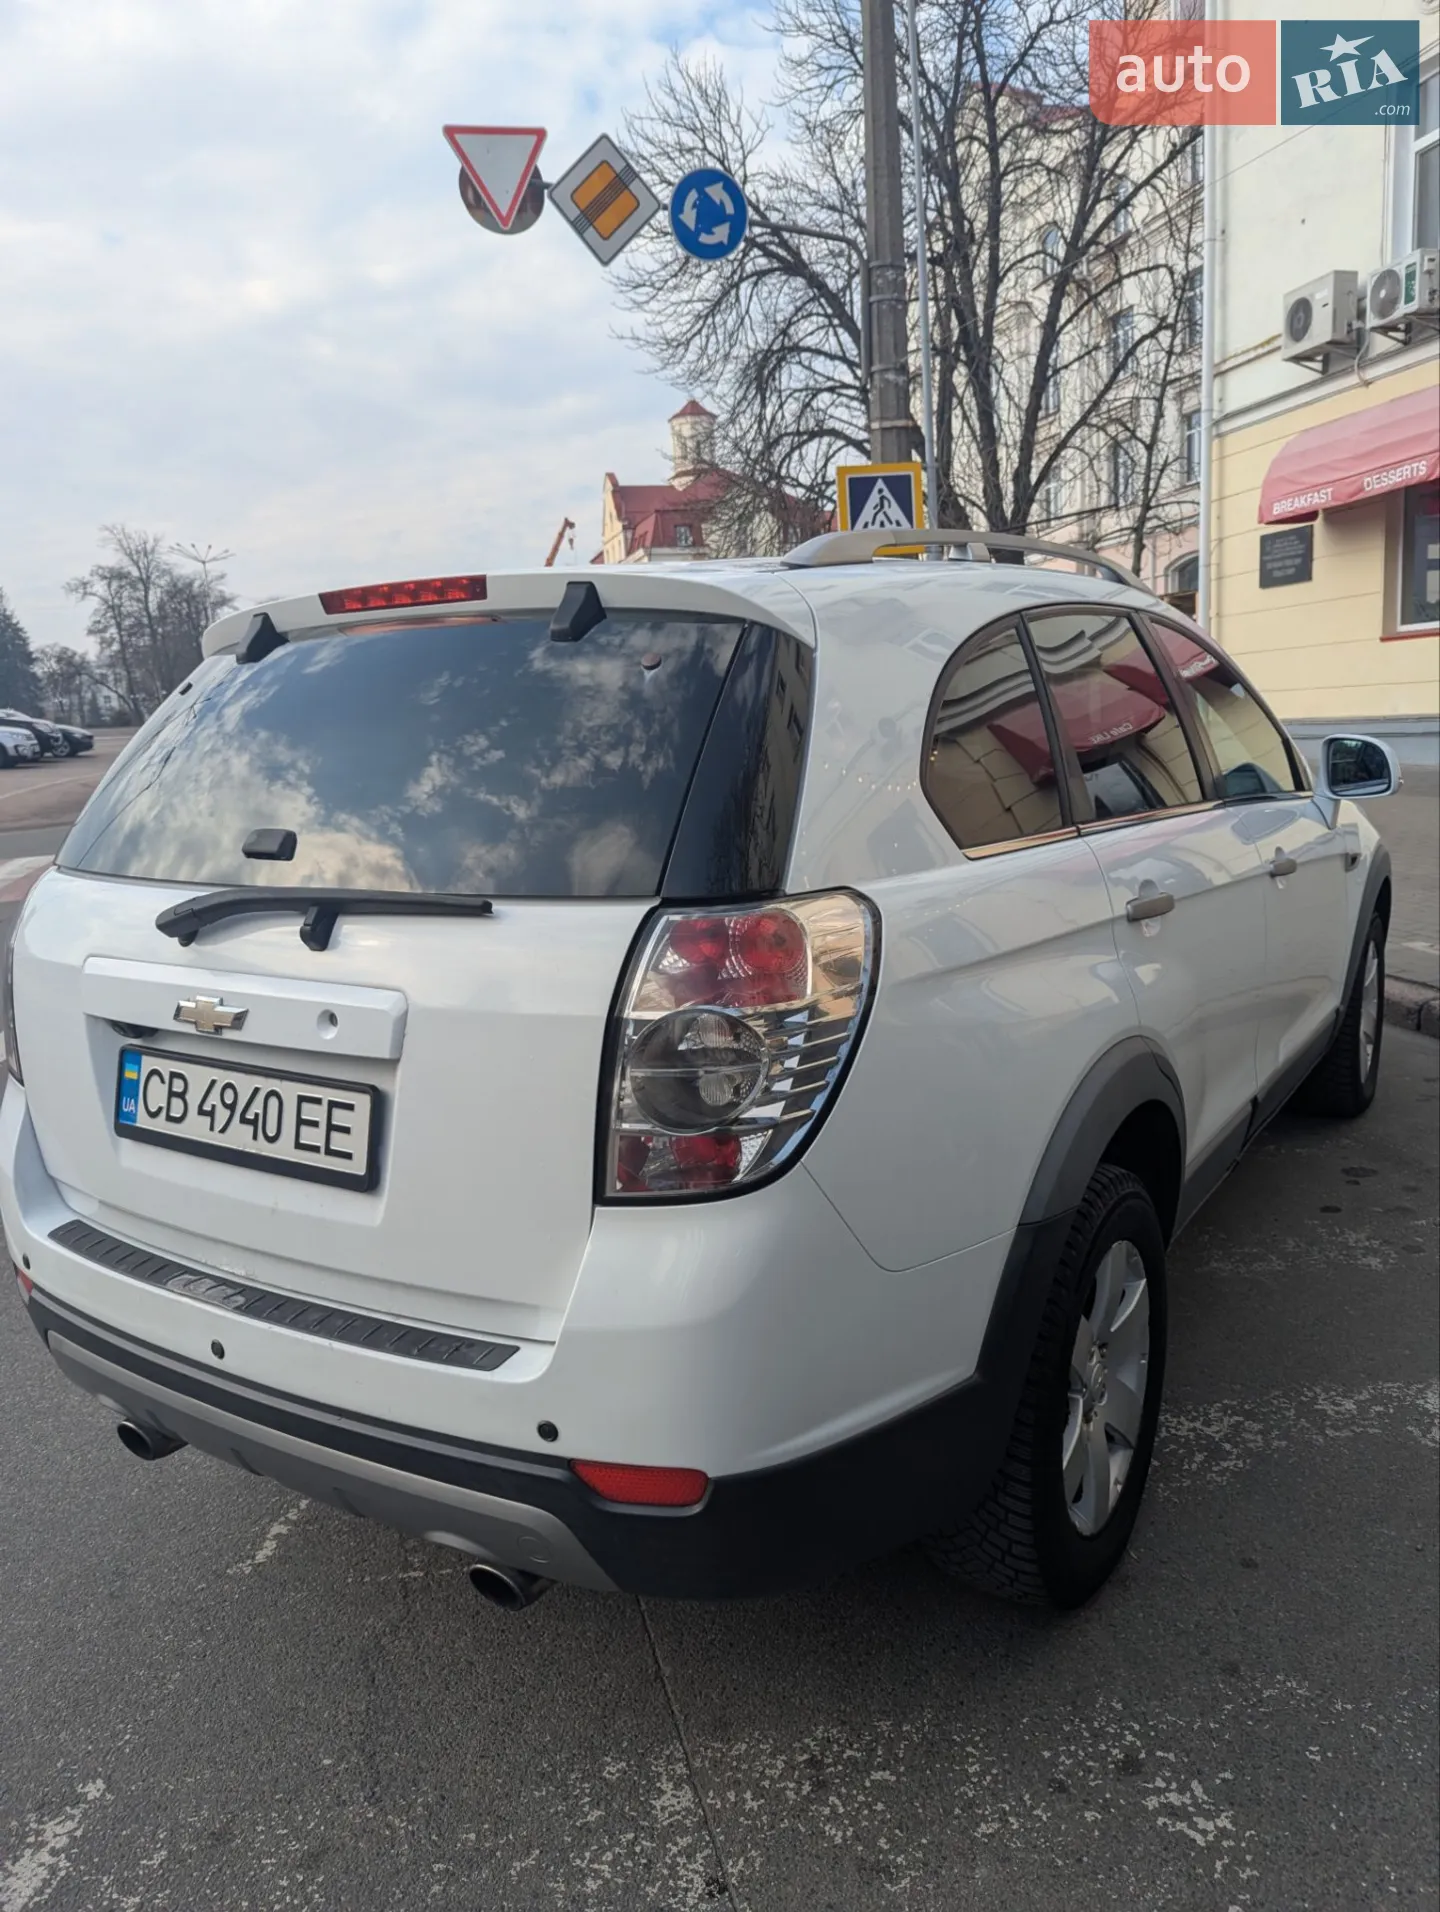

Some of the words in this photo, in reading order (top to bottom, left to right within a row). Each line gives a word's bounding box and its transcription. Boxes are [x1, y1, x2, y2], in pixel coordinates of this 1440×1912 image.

[1272, 488, 1333, 515] BREAKFAST
[1363, 460, 1428, 491] DESSERTS
[122, 1096, 136, 1113] UA
[142, 1067, 189, 1124] CB
[197, 1078, 284, 1144] 4940
[294, 1094, 355, 1160] EE
